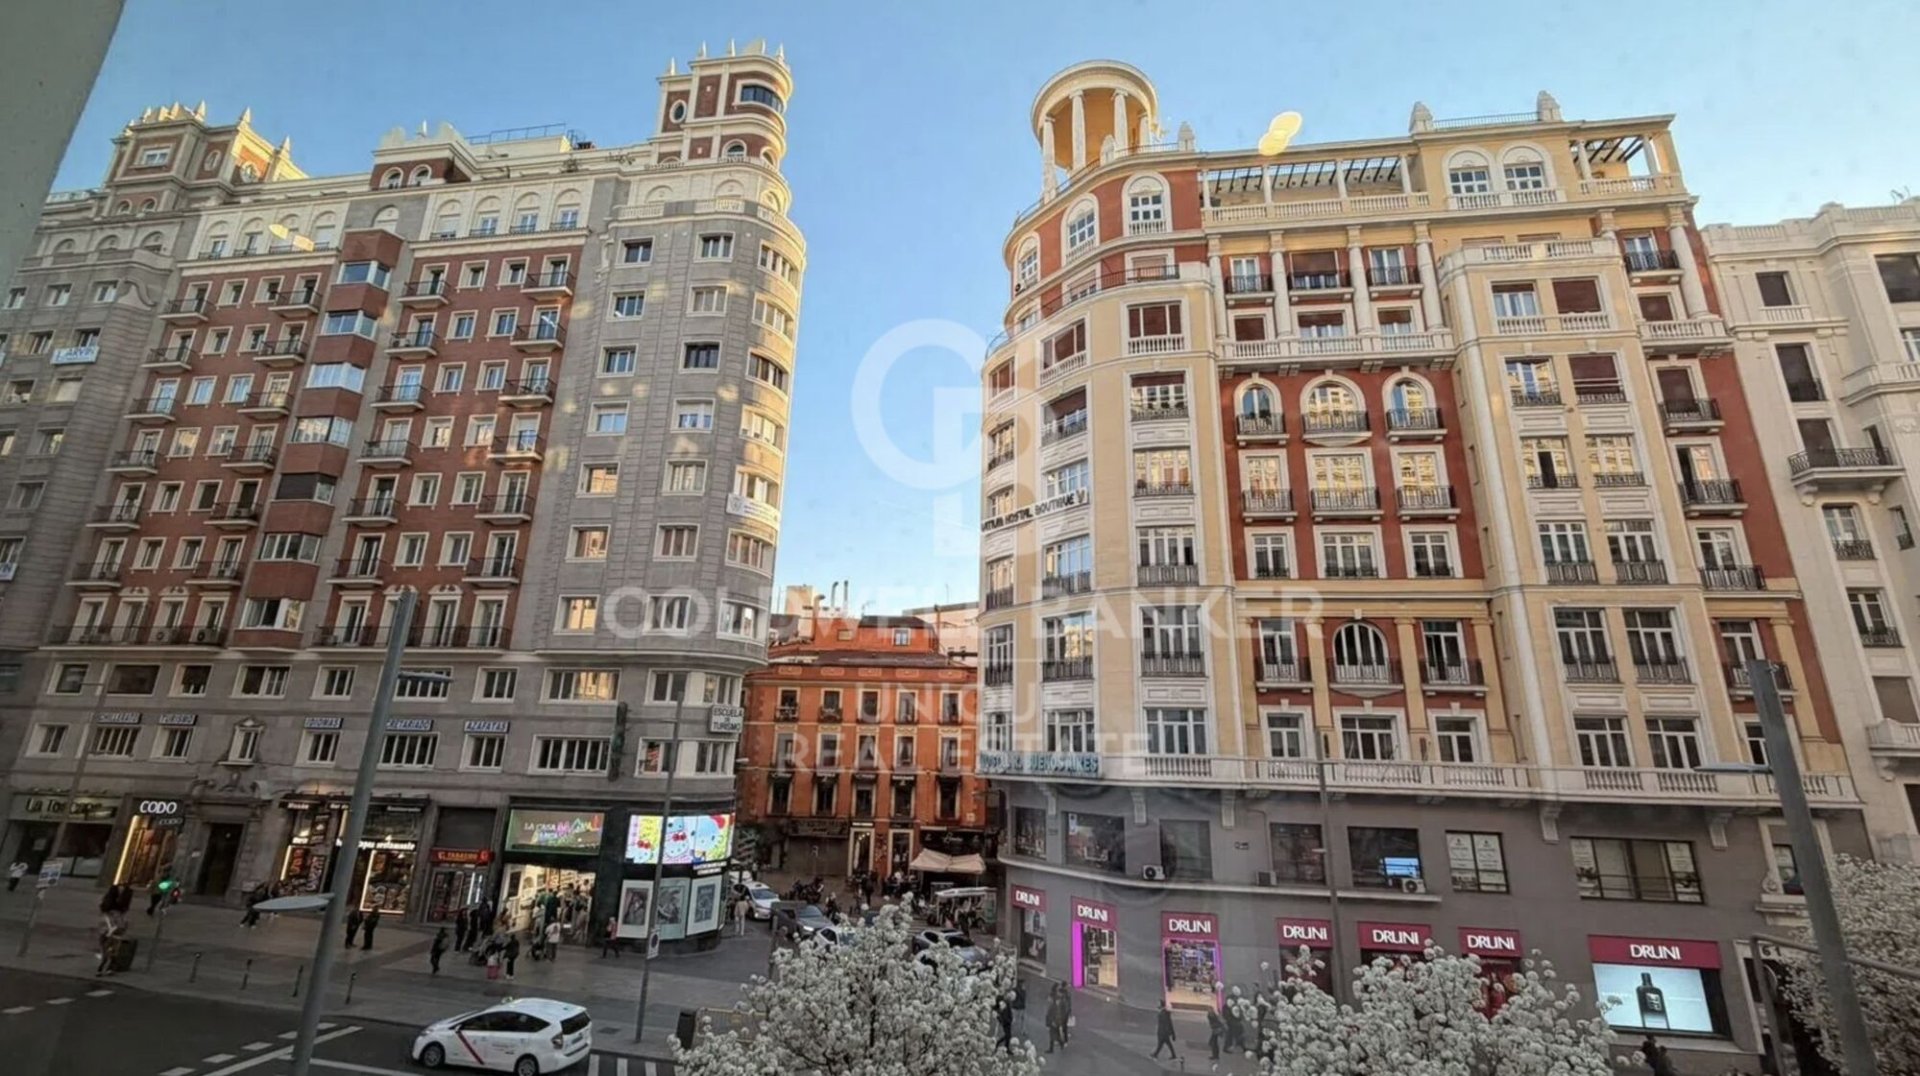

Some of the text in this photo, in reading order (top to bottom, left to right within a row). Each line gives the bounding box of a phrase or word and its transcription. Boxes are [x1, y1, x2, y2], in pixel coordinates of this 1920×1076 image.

[1005, 508, 1033, 524] HOSTAL
[1035, 492, 1075, 516] BOUTIQUE
[713, 707, 742, 717] ESCUELA
[467, 721, 506, 731] AZAFATAS
[713, 721, 741, 731] TURISMO
[1066, 755, 1098, 773] AIRES
[139, 800, 178, 814] CODO
[1016, 890, 1040, 906] DRUNI
[1077, 904, 1108, 922] DRUNI
[1169, 918, 1212, 933] DRUNI
[1283, 925, 1328, 940] DRUNI
[1372, 929, 1419, 945] DRUNI
[1467, 934, 1515, 950] DRUNI
[1630, 943, 1682, 960] DRUNI
[1762, 944, 1782, 957] 61
